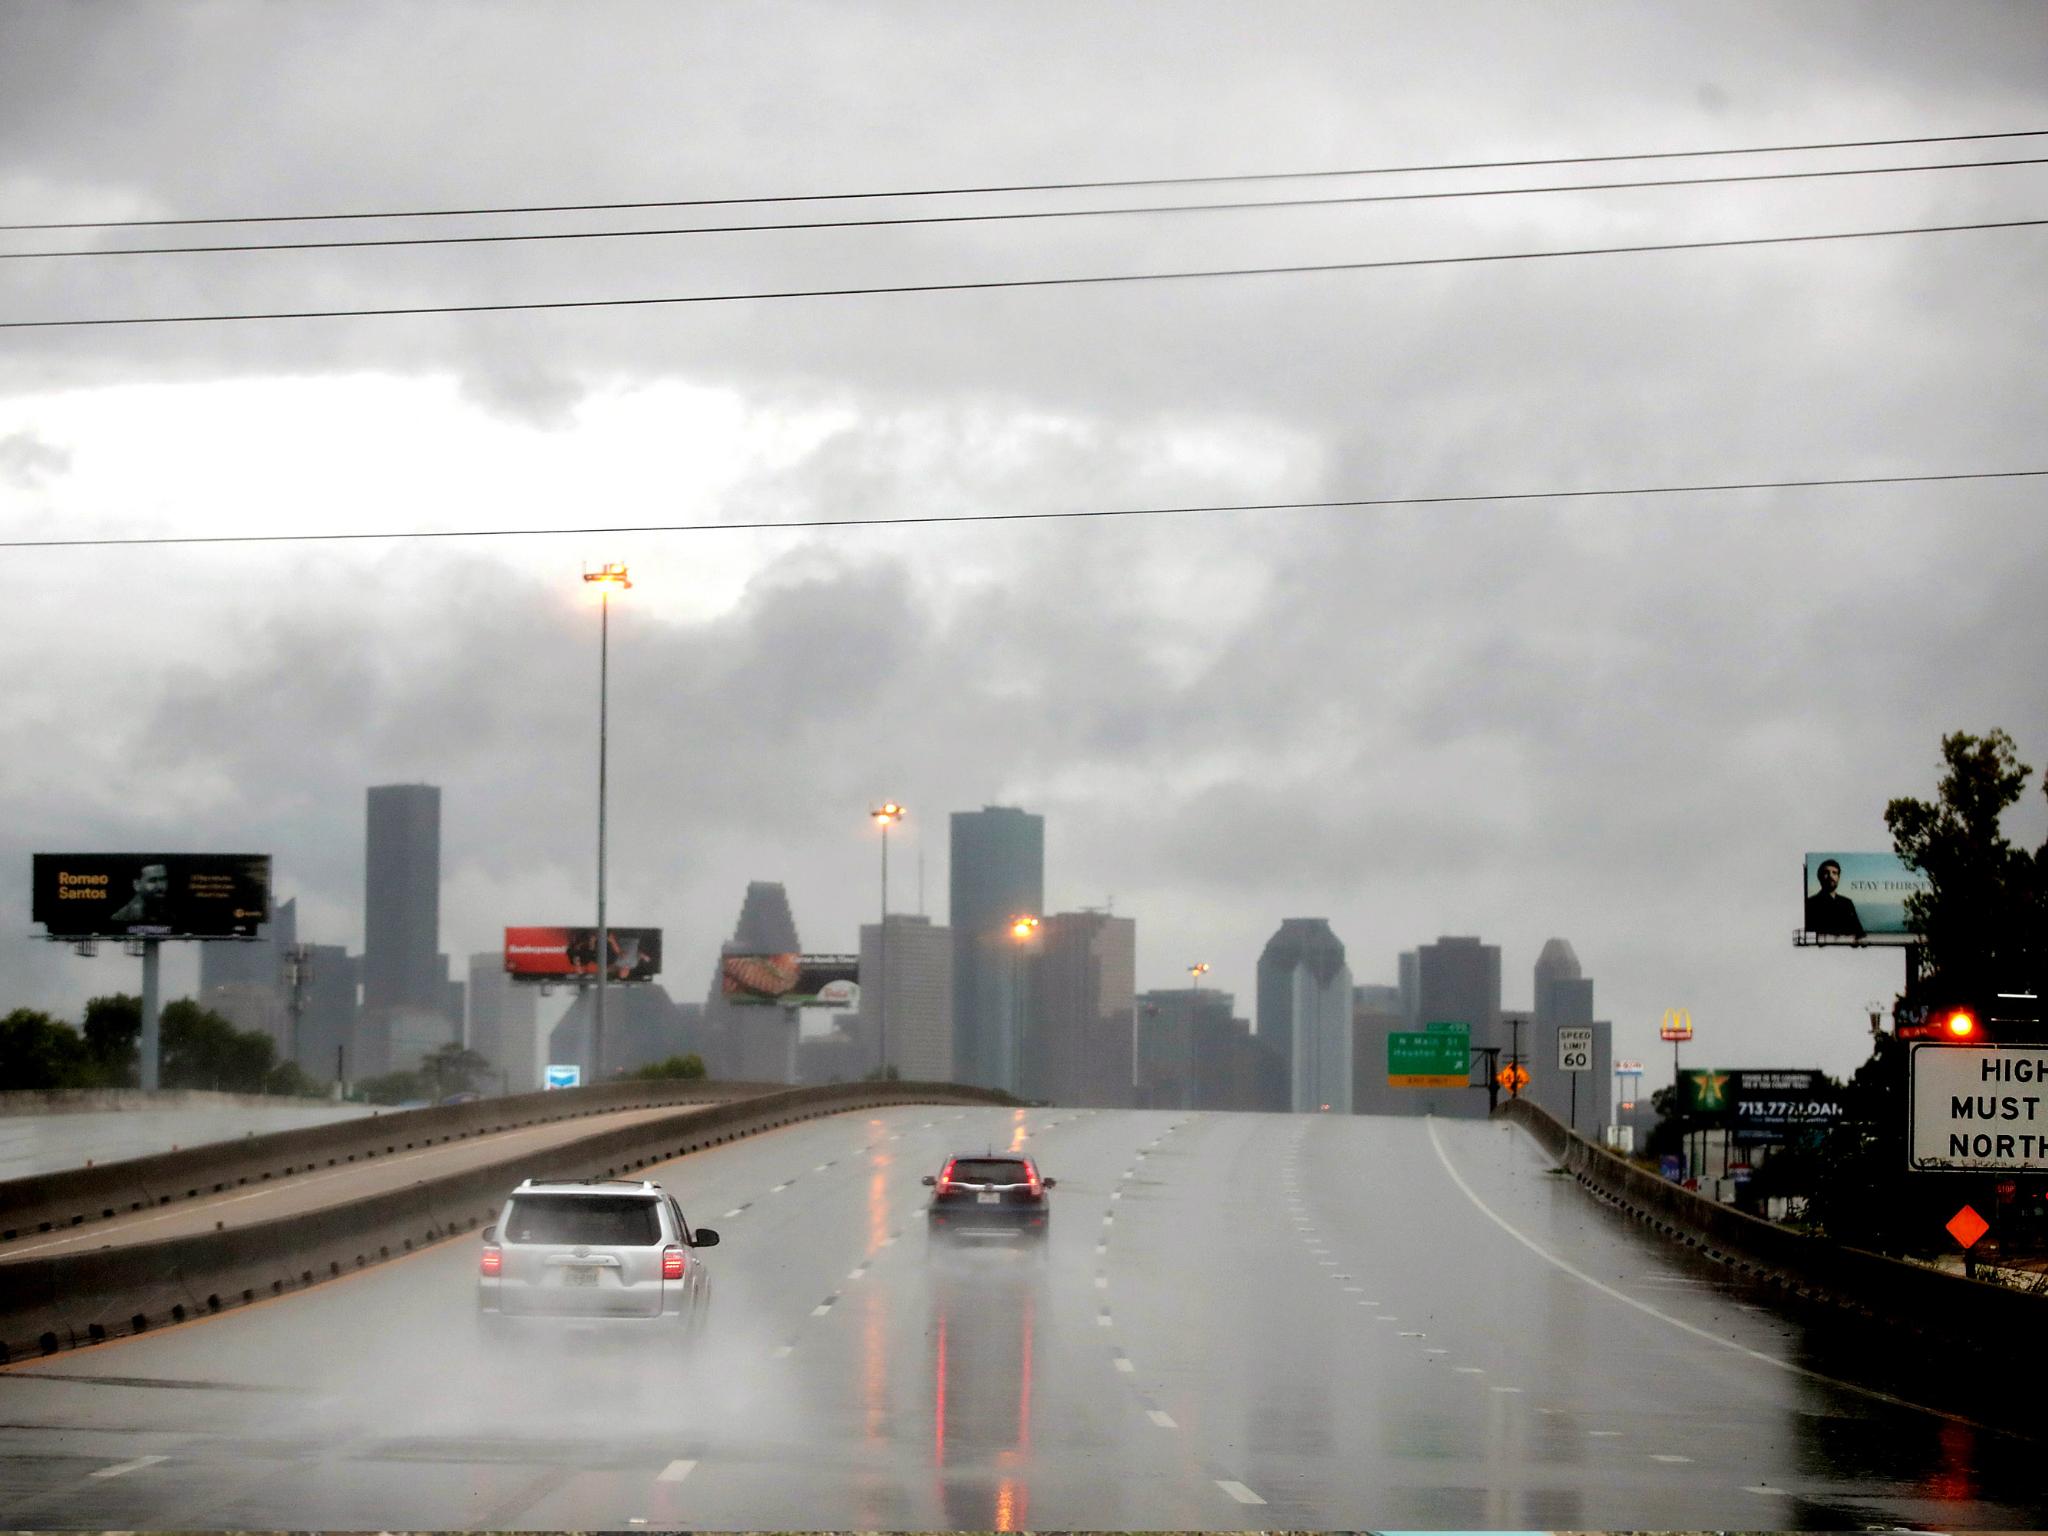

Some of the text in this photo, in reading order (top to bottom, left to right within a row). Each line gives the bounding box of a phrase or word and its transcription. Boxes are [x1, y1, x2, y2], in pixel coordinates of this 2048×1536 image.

[59, 871, 109, 885] Romeo
[1851, 880, 1880, 890] STAY
[59, 886, 107, 899] Santos
[1561, 1031, 1591, 1039] SPEED
[1563, 1042, 1586, 1050] LIMIT
[1564, 1053, 1587, 1066] 60
[1951, 1096, 2040, 1120] MUST
